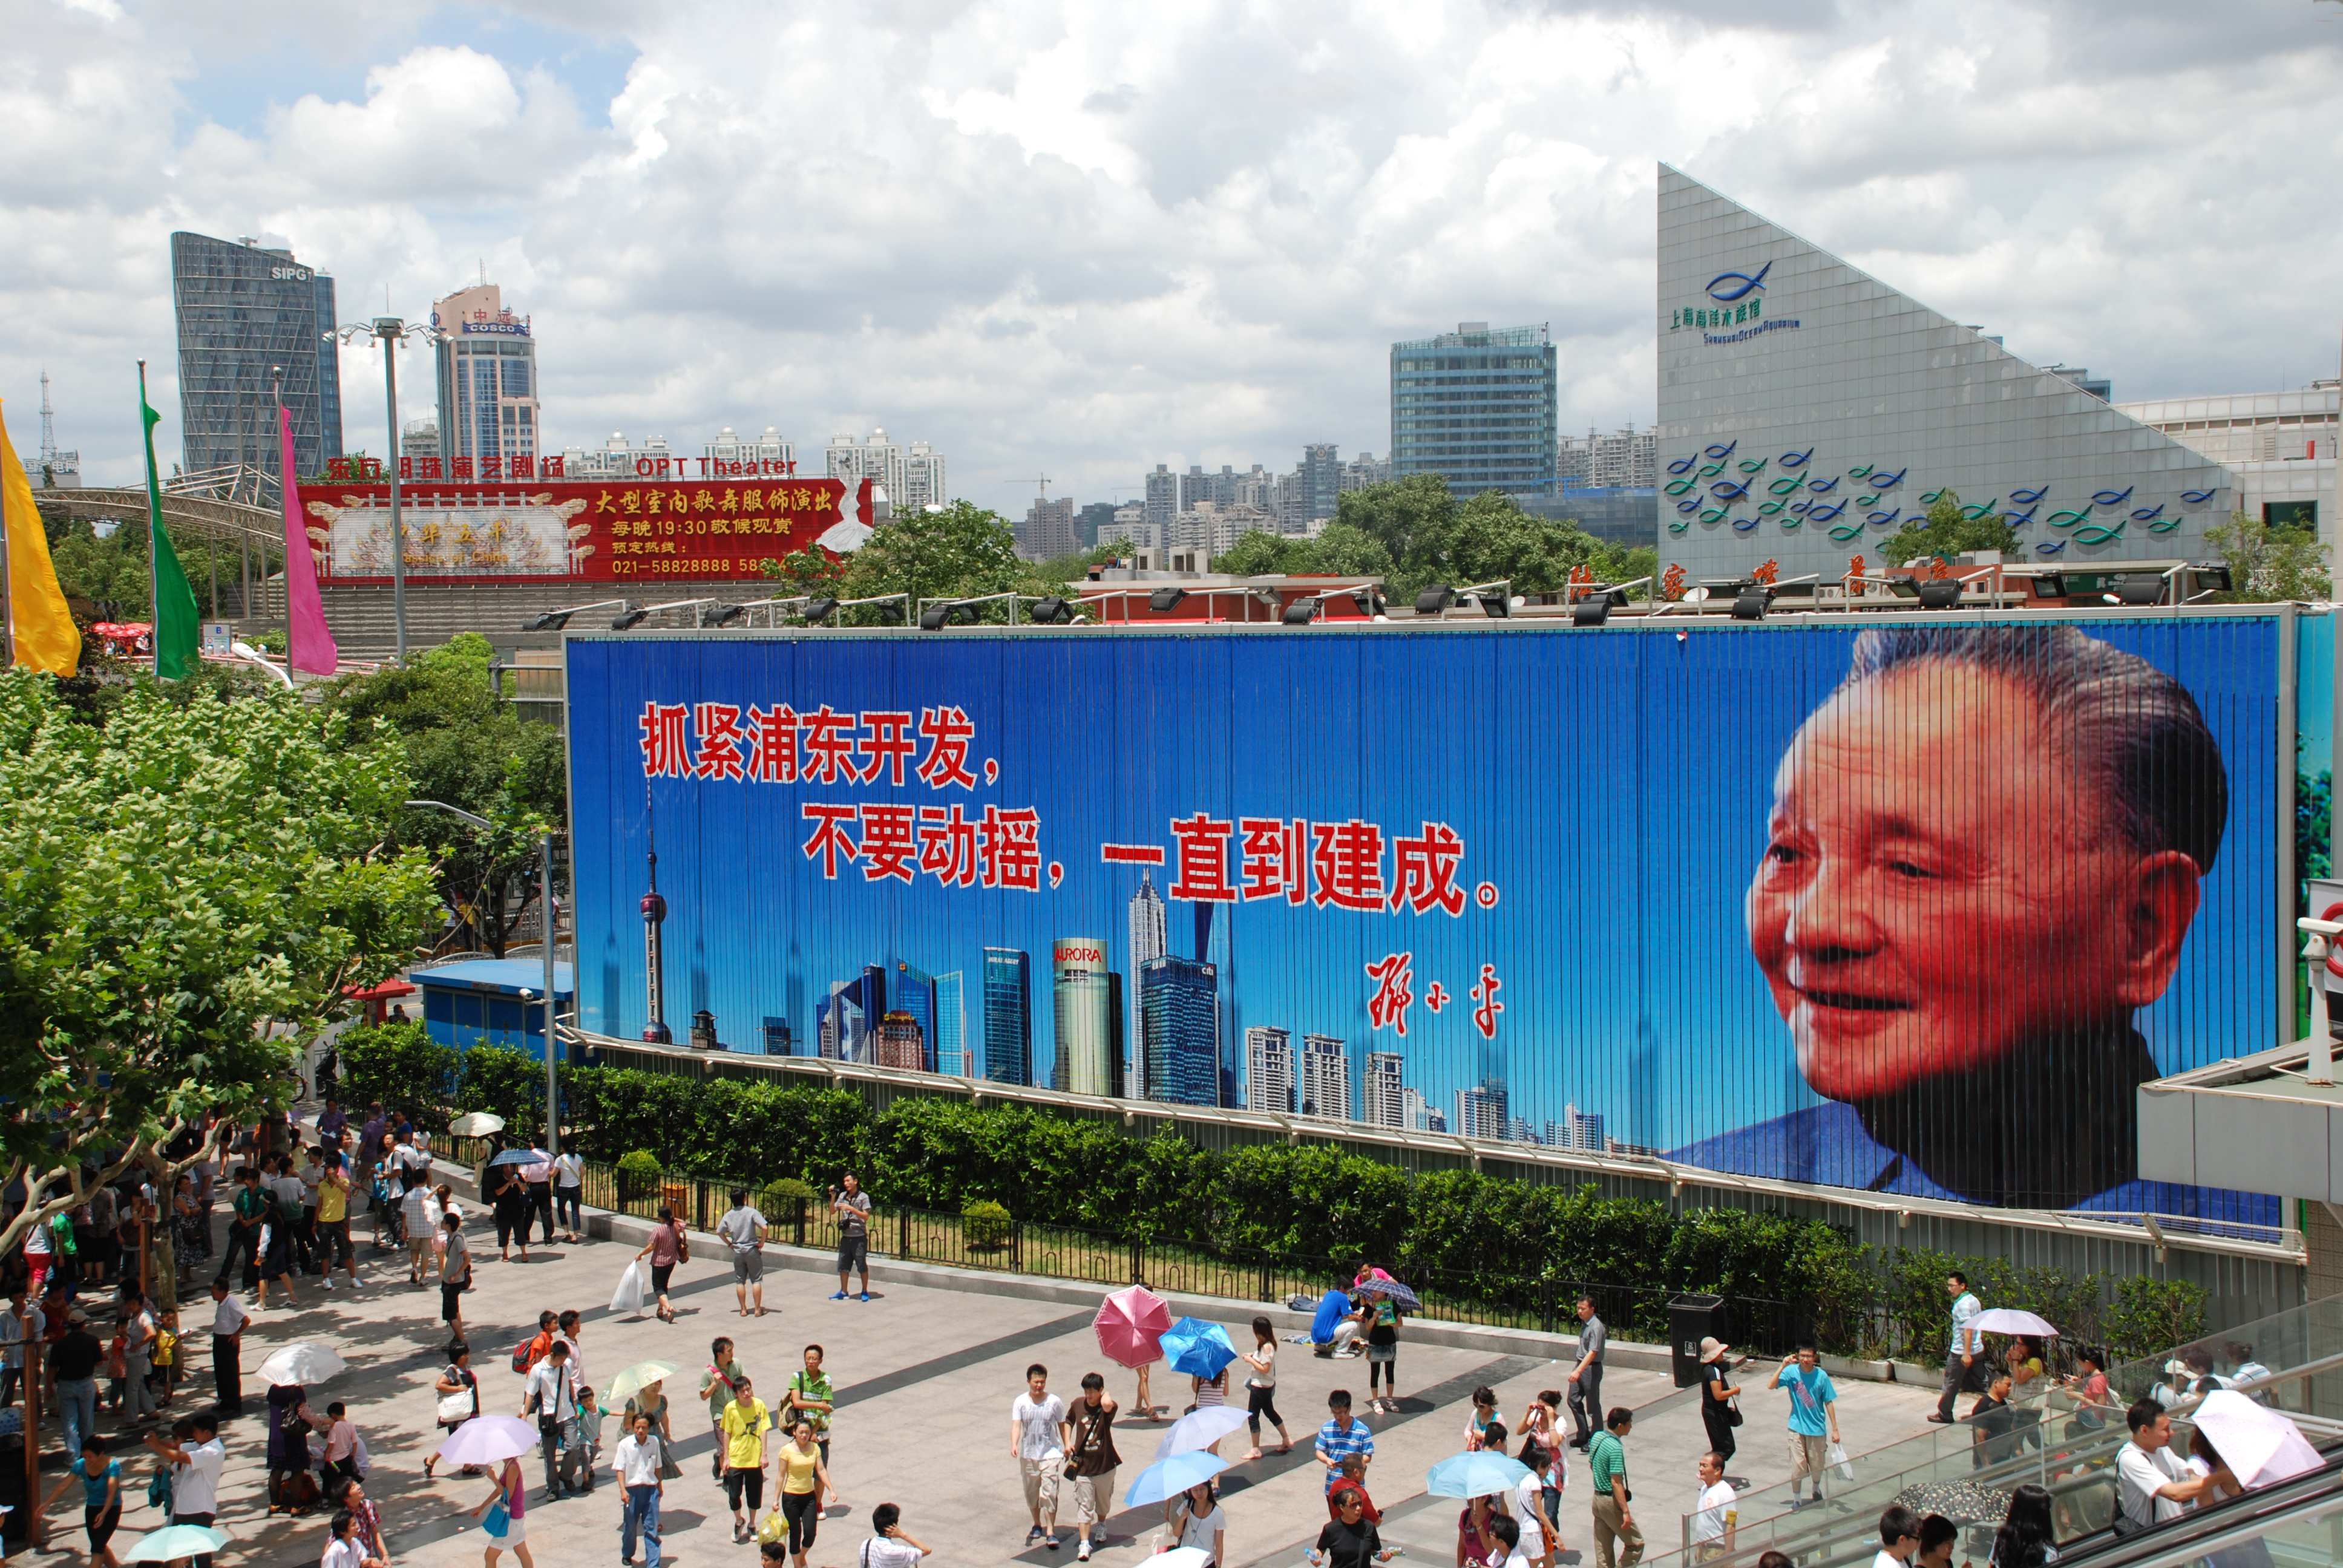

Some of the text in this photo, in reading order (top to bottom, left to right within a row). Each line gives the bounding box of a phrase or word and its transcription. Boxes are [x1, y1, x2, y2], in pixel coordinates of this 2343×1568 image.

[272, 267, 307, 281] SIPG
[473, 309, 511, 324] 中远
[470, 324, 515, 333] COSCO
[636, 457, 797, 477] OPT Theater
[595, 487, 833, 516] 大型室内歌舞服饰演出
[472, 550, 508, 563] China
[1054, 948, 1102, 963] AURORA
